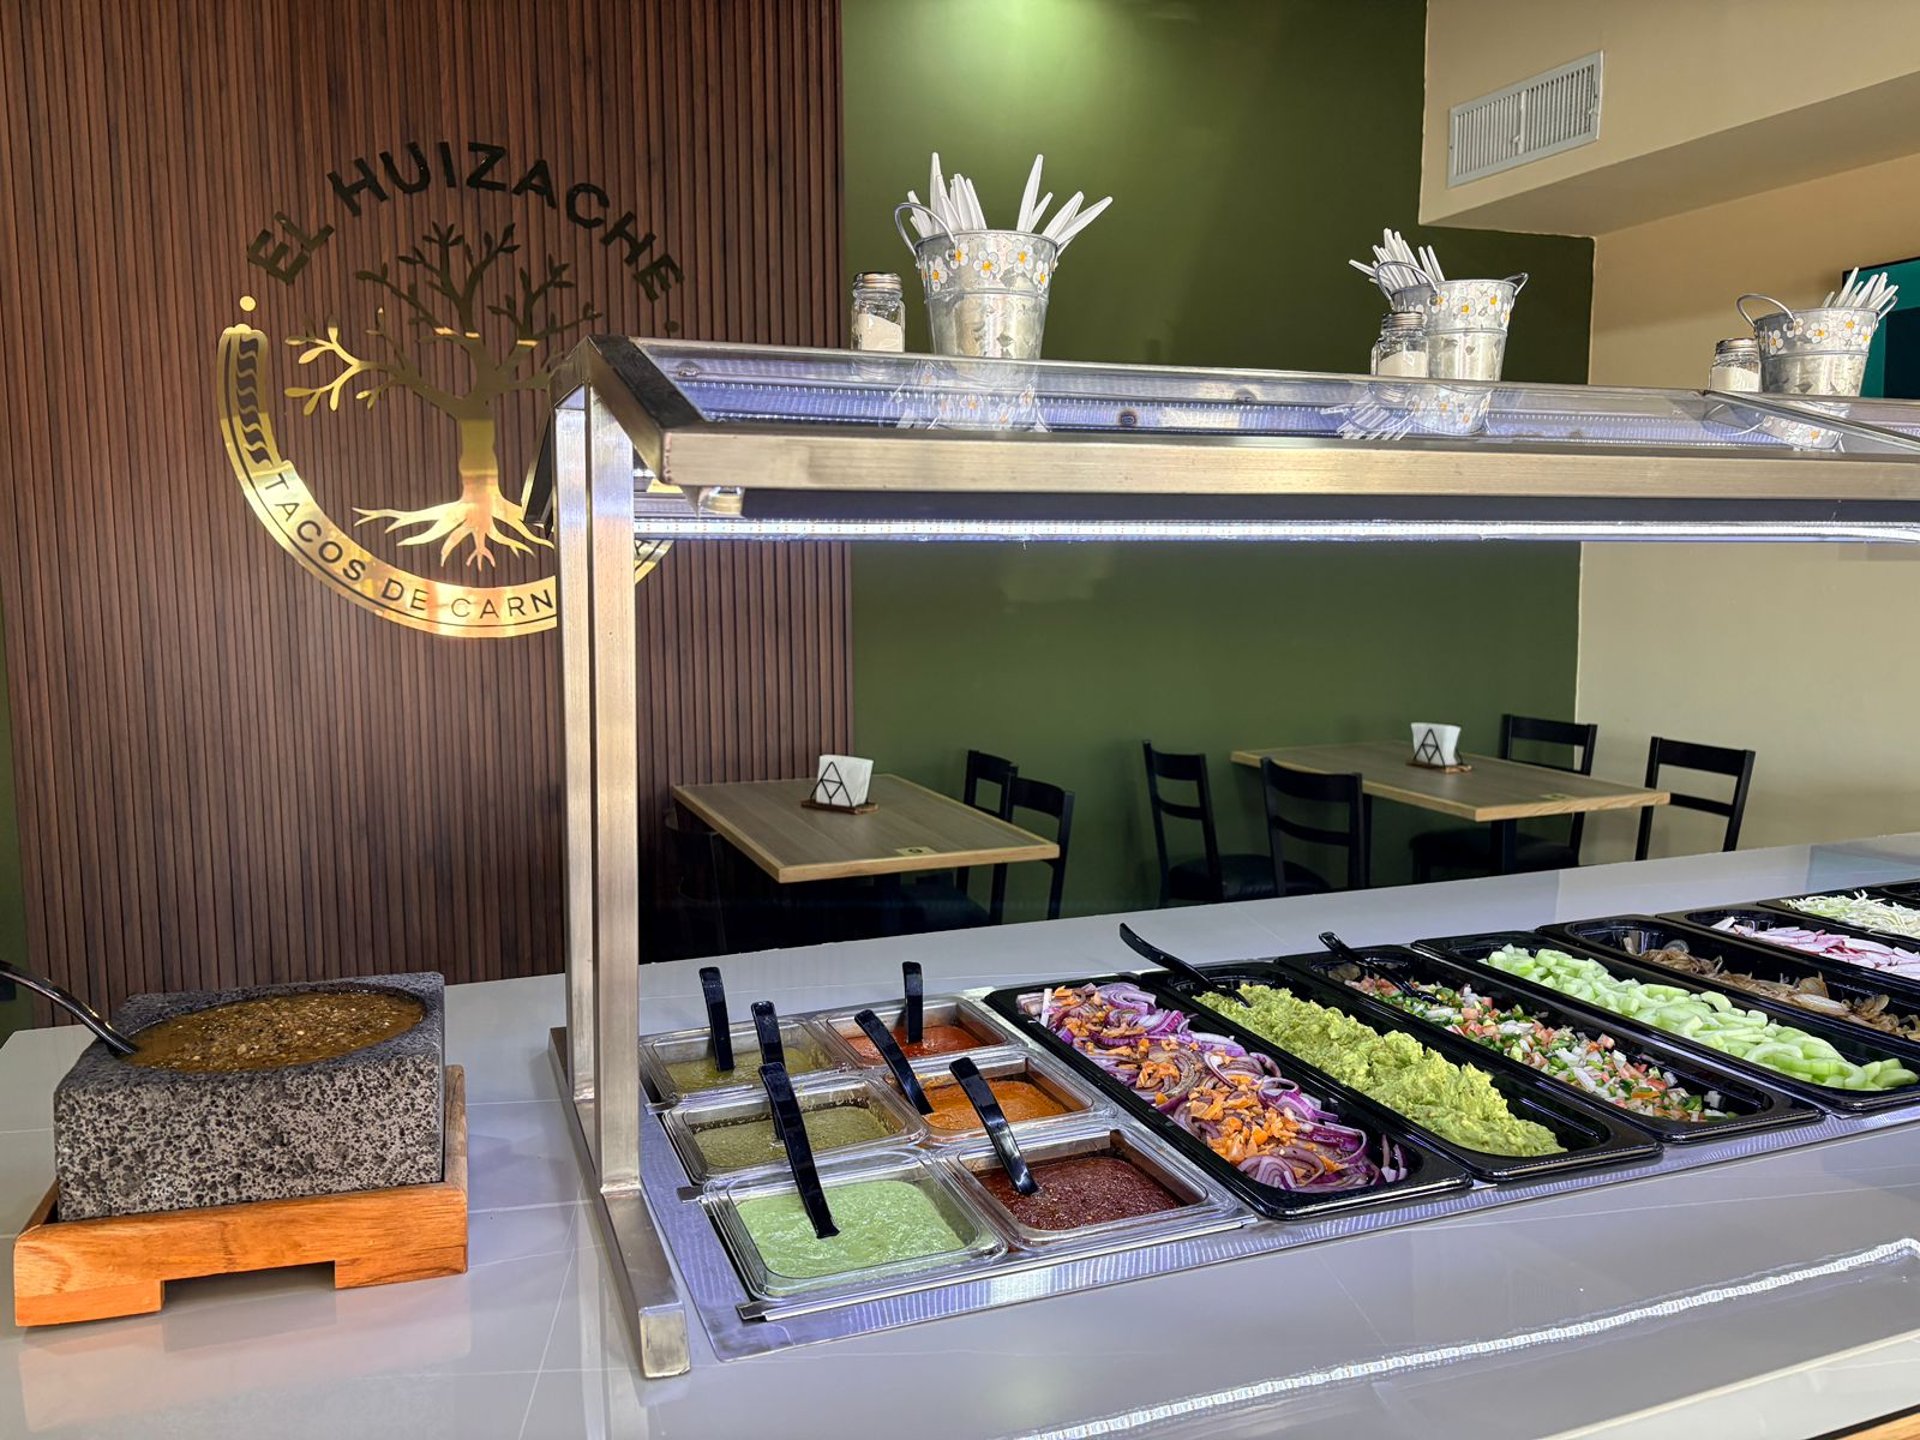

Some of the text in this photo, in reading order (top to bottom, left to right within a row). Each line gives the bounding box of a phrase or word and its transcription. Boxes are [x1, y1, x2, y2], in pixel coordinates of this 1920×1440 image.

[248, 141, 685, 302] EL HUIZACHE
[264, 472, 555, 619] TACOS DE CARN
